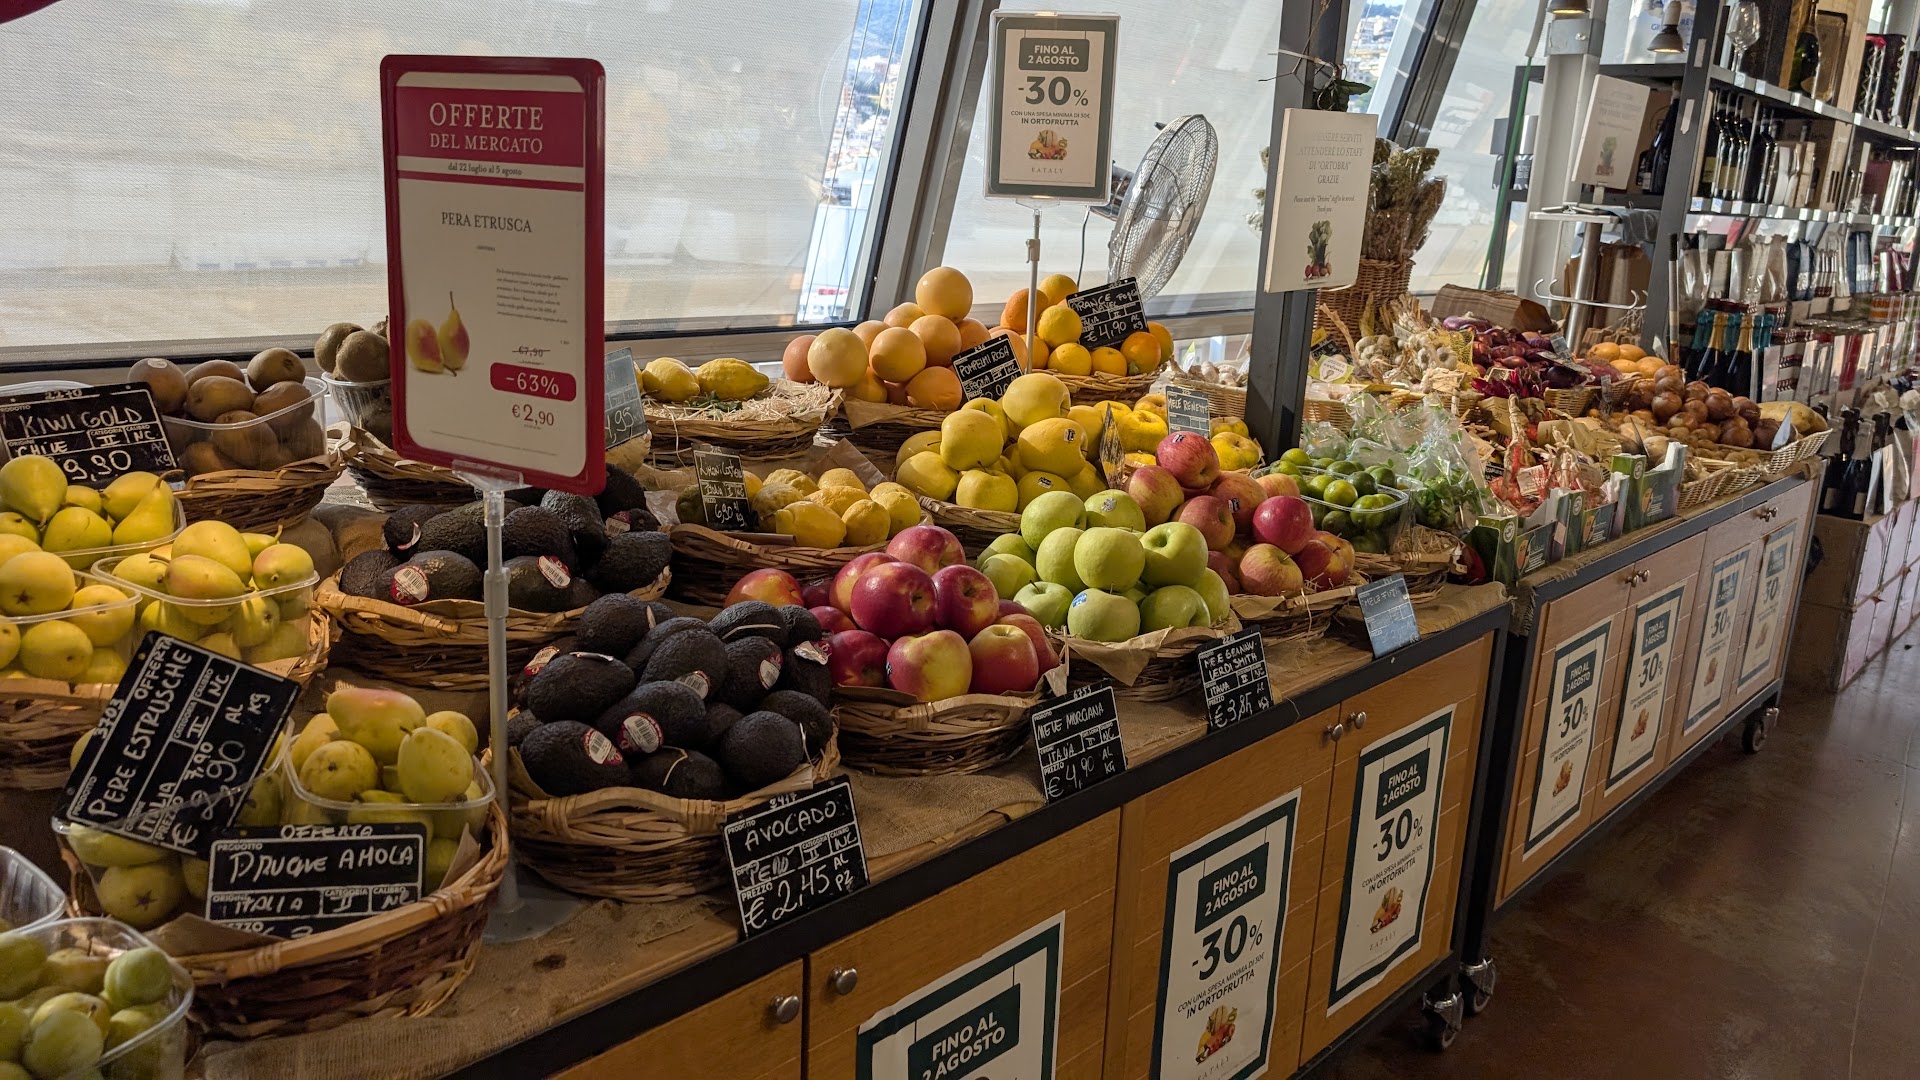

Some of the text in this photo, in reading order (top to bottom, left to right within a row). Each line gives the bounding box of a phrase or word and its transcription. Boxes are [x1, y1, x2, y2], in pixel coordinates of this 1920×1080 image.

[1028, 55, 1080, 66] 2 AGOSTO
[1034, 45, 1075, 55] FINO AL
[1018, 76, 1089, 107] -30%
[429, 102, 544, 131] OFFERTE
[1030, 118, 1079, 126] ORTOFRUTTA
[430, 133, 543, 154] DEL MERCATO
[1336, 147, 1345, 156] LO
[1346, 147, 1363, 157] STAFF
[447, 161, 522, 177] dal 22 luglio al 5 agosto
[1309, 161, 1316, 170] DI
[1317, 174, 1339, 184] GRAZIE
[442, 211, 532, 232] PERA ETRUSCA
[1099, 321, 1127, 340] 4,90
[518, 346, 544, 358] €7,90
[991, 345, 1010, 361] ROSA
[506, 372, 560, 396] -63%
[0, 404, 31, 413] RODOTTO
[19, 405, 143, 438] KIWI GOLD
[90, 427, 124, 436] CATEGORIA
[133, 430, 156, 443] NC
[134, 636, 175, 700] OFFERTA
[1233, 652, 1257, 668] SMITH
[1570, 661, 1590, 680] FINO AL
[195, 668, 214, 698] CALIBRO
[1565, 671, 1590, 694] 2 AGOSTO
[186, 715, 210, 741] II
[208, 673, 230, 697] NC
[225, 702, 245, 724] AL
[1066, 702, 1104, 729] MORGANA
[1558, 697, 1590, 738] -30%
[173, 701, 197, 739] CATEGORIA
[87, 649, 193, 818] PERE ESTRUSCHE
[1102, 746, 1113, 760] AL
[1043, 762, 1064, 775] PREZZO
[1388, 764, 1418, 789] FINO AL
[72, 775, 98, 816] PRODOTTO
[1047, 777, 1064, 797] €
[1382, 776, 1420, 806] 2 AGOSTO
[171, 822, 199, 847] €
[281, 824, 374, 840] OFFERTA
[744, 801, 837, 851] AVOCADO
[1372, 808, 1423, 862] -30%
[216, 842, 263, 851] PRODOTTO
[834, 832, 857, 850] NC
[833, 853, 849, 870] AL
[835, 870, 854, 892] PZ
[1212, 862, 1254, 897] FINO AL
[1362, 877, 1373, 888] CON
[1373, 871, 1384, 881] UNA
[1384, 862, 1397, 874] SPESA
[1368, 857, 1416, 894] IN ORTOFRUTTA
[324, 887, 368, 896] CATEGORIA
[372, 885, 406, 894] CALIBRO
[741, 882, 773, 901] PREZZO
[744, 864, 830, 929] € 2,45
[1205, 876, 1258, 917] 2 AGOSTO
[1192, 914, 1263, 981] -30%
[1177, 999, 1193, 1013] CON
[1193, 989, 1207, 1004] UNA
[1208, 979, 1225, 995] SPESA
[1226, 964, 1248, 984] MINIMA
[1248, 960, 1255, 971] DI
[1186, 969, 1255, 1019] IN ORTOFRUTTA
[933, 1011, 998, 1062] FINO AL
[935, 1026, 1006, 1080] AGOSTO
